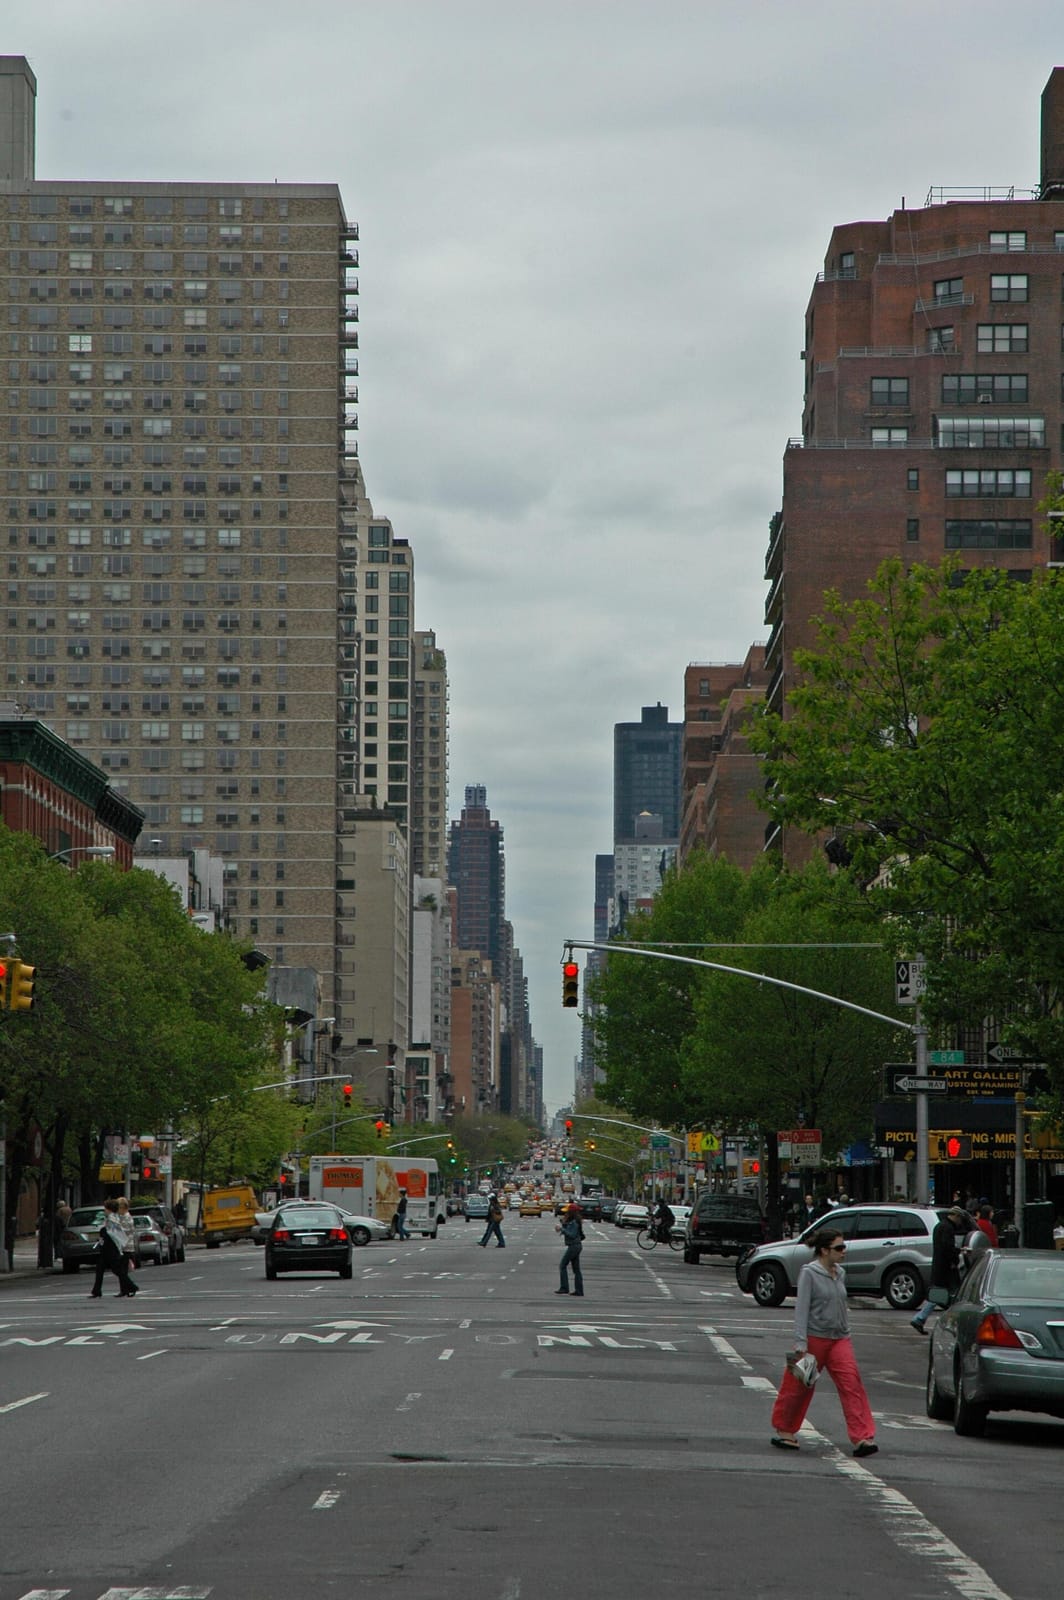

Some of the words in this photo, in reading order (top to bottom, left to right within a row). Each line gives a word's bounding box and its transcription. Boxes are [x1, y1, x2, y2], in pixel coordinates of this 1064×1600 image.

[997, 1047, 1015, 1057] ONE
[940, 1052, 955, 1063] 84
[944, 1070, 969, 1079] ART
[902, 1080, 918, 1088] ONE
[928, 1080, 944, 1089] WAY
[947, 1081, 977, 1089] USTOM
[885, 1131, 918, 1143] PICTU
[992, 1150, 1016, 1160] CUSTO
